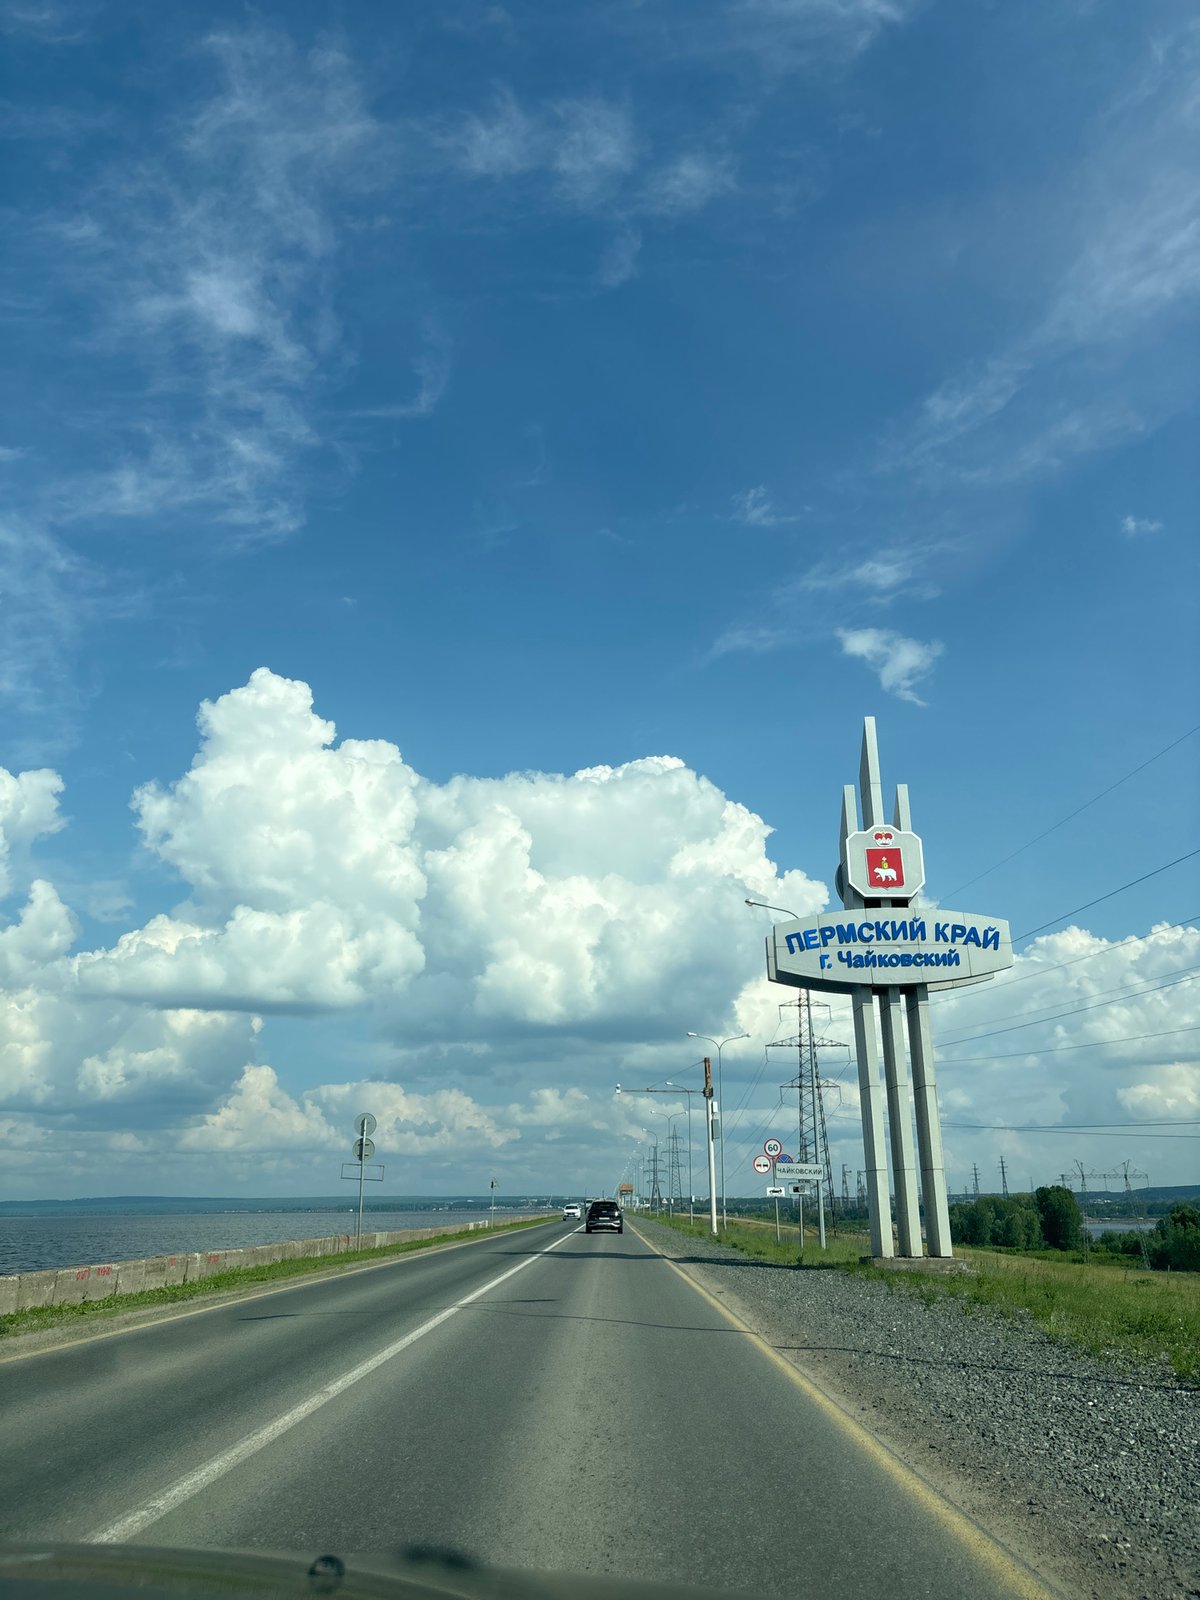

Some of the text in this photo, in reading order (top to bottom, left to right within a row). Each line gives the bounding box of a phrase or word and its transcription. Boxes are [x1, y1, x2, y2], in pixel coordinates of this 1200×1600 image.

[785, 917, 1000, 954] ПЕРМСКИЙ КРАЙ
[838, 948, 960, 969] Чайковский
[767, 1144, 778, 1152] 60
[777, 1166, 823, 1175] ЧАЙКОВСКИЙ
